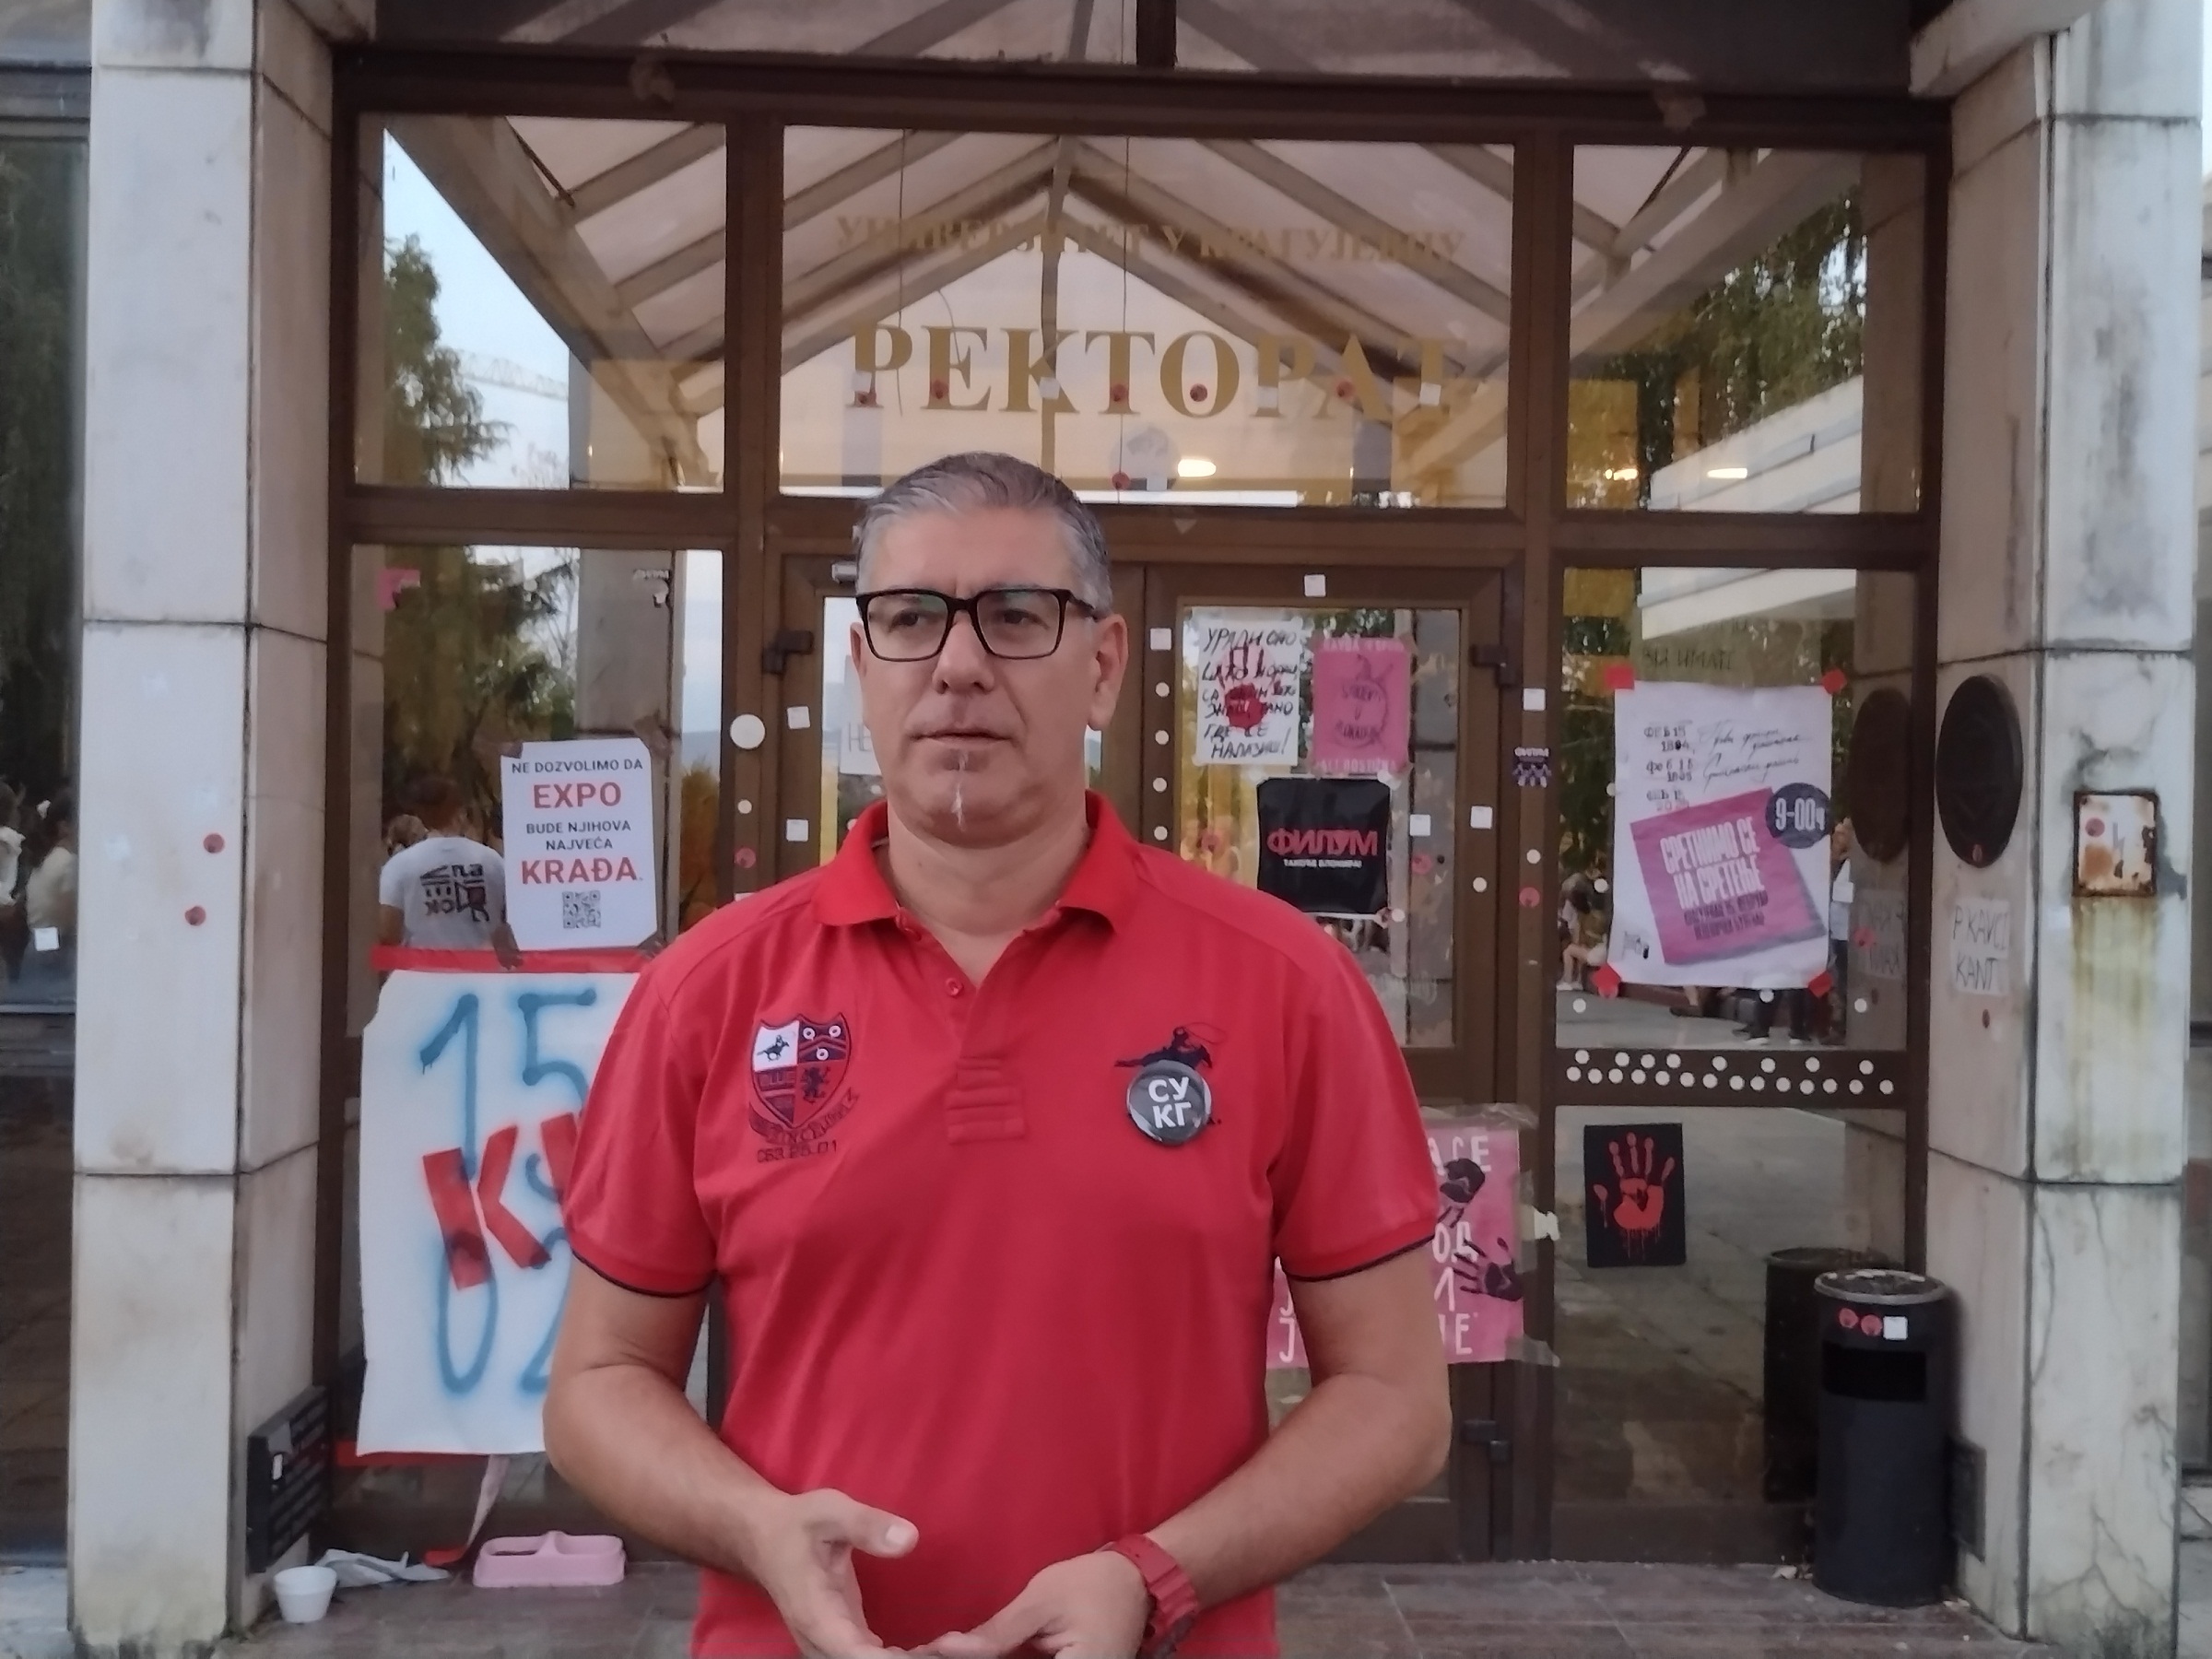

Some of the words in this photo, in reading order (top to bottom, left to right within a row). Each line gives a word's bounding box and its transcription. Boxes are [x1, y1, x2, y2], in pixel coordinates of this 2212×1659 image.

[847, 323, 1466, 419] РЕКТОРАТ
[512, 761, 530, 774] NE
[535, 759, 619, 773] DOZVOLIMO
[624, 758, 643, 771] DA
[533, 782, 622, 808] EXPO
[526, 822, 564, 835] BUDE
[568, 820, 631, 834] NJIHOVA
[546, 837, 614, 851] NAJVEĆA
[1147, 1075, 1191, 1104] СУ
[1151, 1100, 1193, 1130] КГ
